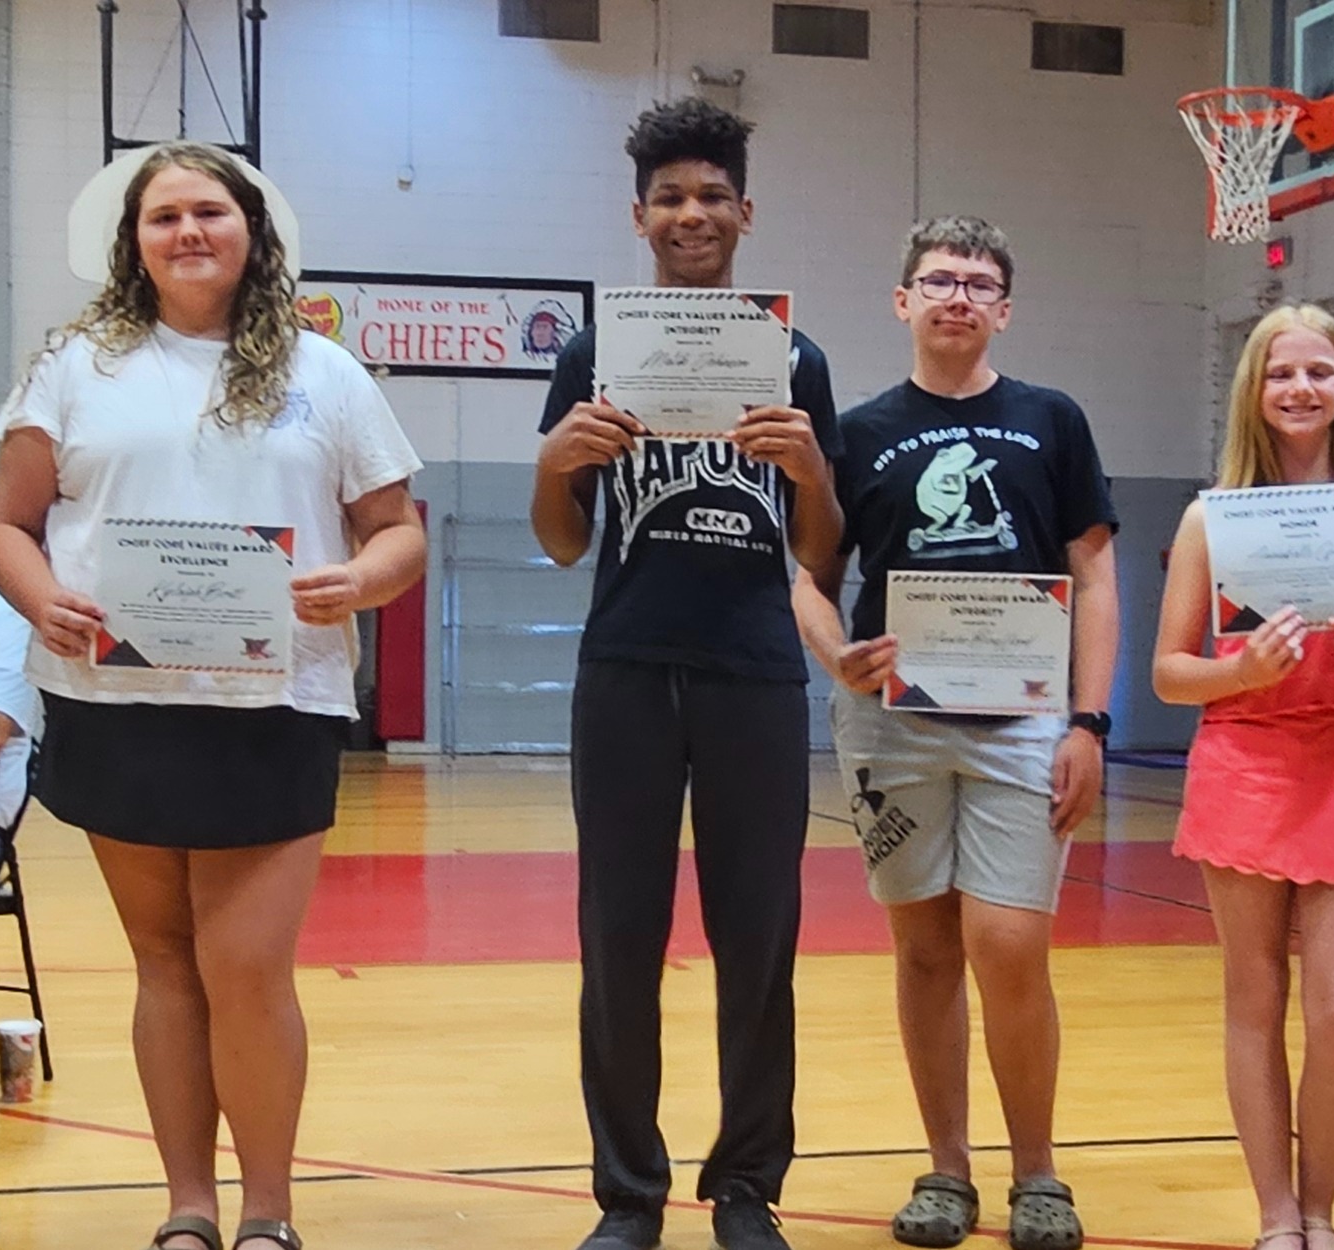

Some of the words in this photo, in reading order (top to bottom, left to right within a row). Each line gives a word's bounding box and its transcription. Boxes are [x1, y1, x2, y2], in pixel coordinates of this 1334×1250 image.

[377, 299, 424, 312] HOME
[431, 300, 452, 313] OF
[458, 302, 490, 314] THE
[616, 310, 649, 320] CHIEF
[652, 310, 682, 320] CORE
[684, 311, 726, 321] VALUES
[729, 312, 770, 322] AWARD
[664, 325, 721, 335] INTEGRITY
[360, 321, 507, 363] CHIEFS
[897, 438, 919, 453] TO
[919, 427, 970, 445] PRAISE
[973, 427, 1003, 439] THE
[1003, 430, 1041, 450] LORD
[692, 512, 746, 532] MMA
